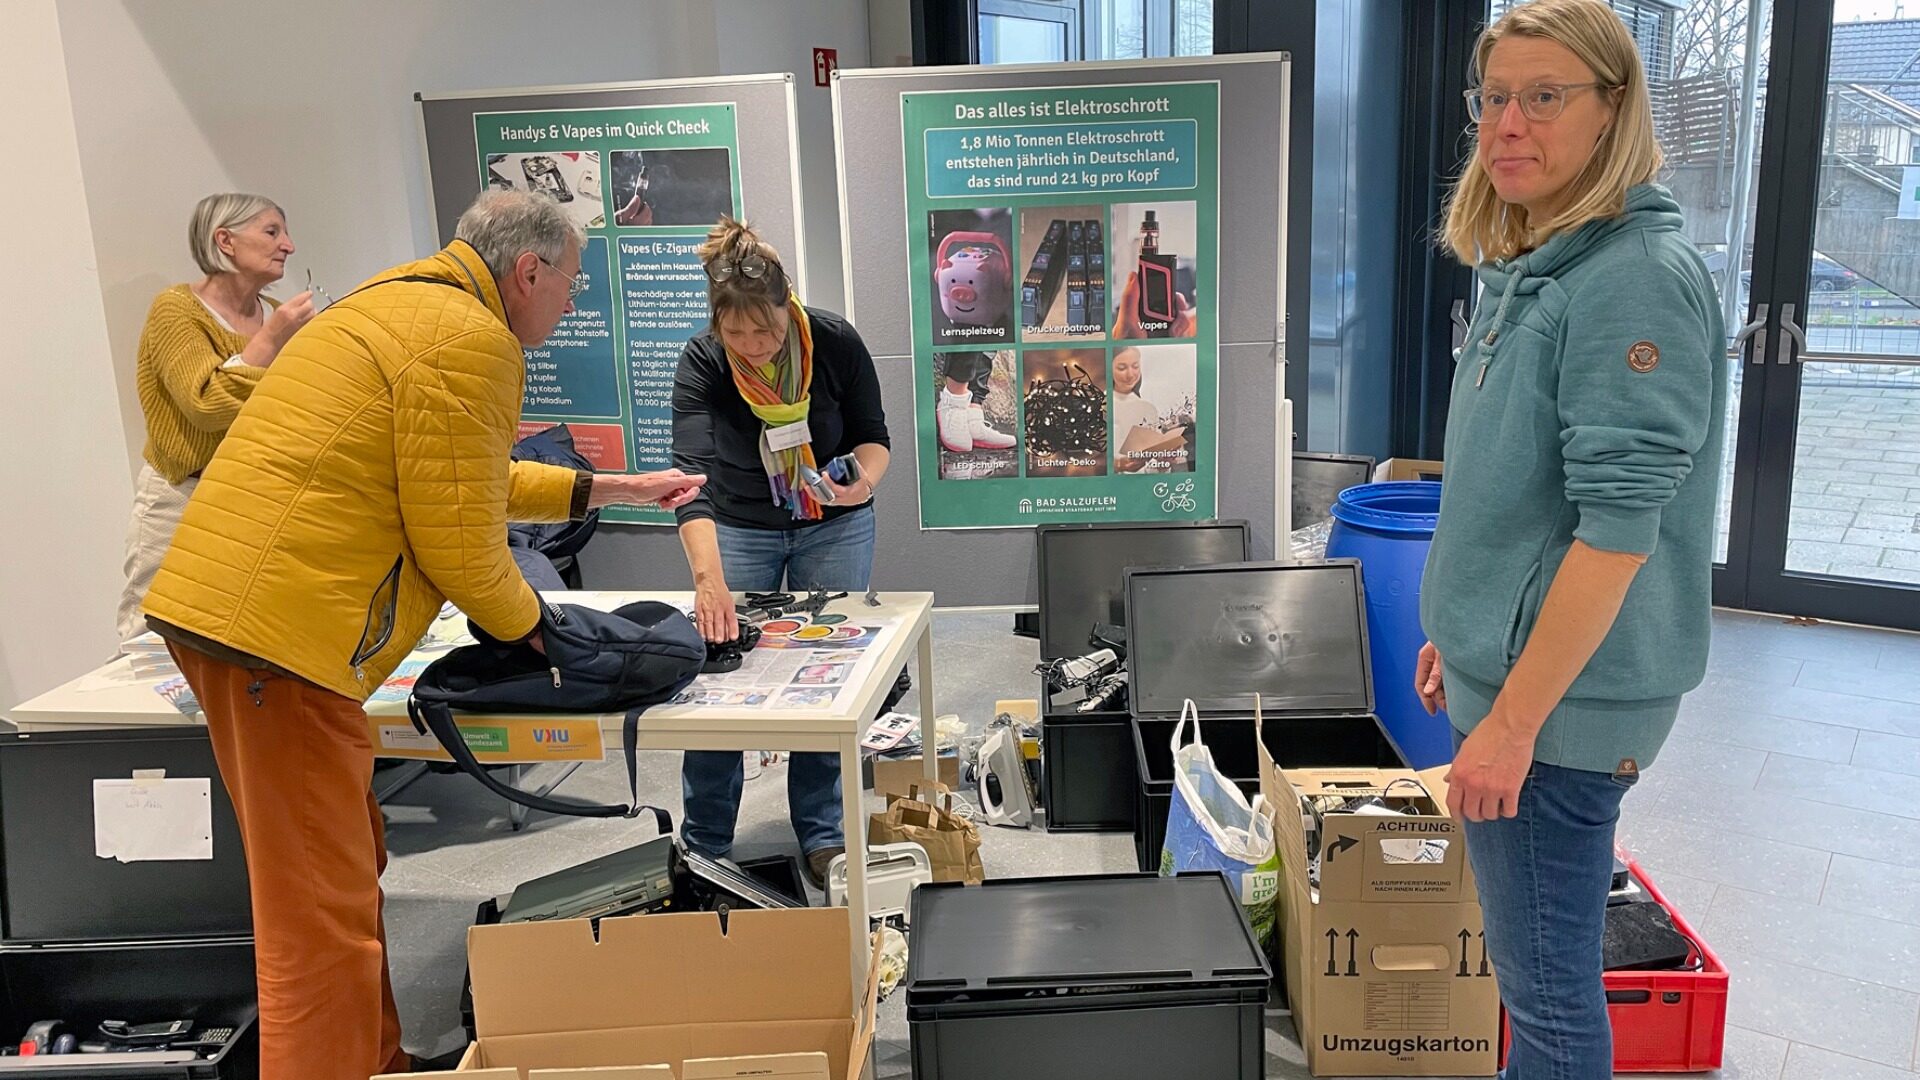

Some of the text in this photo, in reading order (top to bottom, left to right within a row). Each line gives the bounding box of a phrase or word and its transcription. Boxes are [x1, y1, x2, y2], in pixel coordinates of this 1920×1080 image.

[955, 97, 1170, 119] Das alles ist Elektroschrott
[500, 118, 710, 142] Handys & Vapes im Quick Check
[960, 129, 1165, 150] 1,8 Mio Tonnen Elektroschrott
[946, 148, 1180, 171] entstehen jährlich in Deutschland,
[967, 168, 1160, 188] das sind rund 21 kg pro Kopf
[621, 243, 650, 256] Vapes
[661, 262, 672, 271] im
[625, 272, 654, 281] Brände
[627, 290, 708, 300] Beschädigte oder erh
[628, 300, 708, 308] Lithium-Ionen-Akkus
[578, 310, 601, 319] liegen
[629, 310, 658, 318] können
[659, 310, 708, 319] Kurzschlüsse
[569, 321, 606, 329] ungenutzt
[630, 320, 695, 329] Brände auslösen.
[1027, 322, 1101, 335] Druckerpatrone
[1138, 320, 1168, 332] Vapes
[574, 329, 609, 337] Rohstoffe
[941, 326, 1005, 338] Lernspielzeug
[544, 340, 590, 348] martphones:
[631, 340, 688, 350] Falsch entsorgt
[533, 350, 551, 358] Gold
[631, 350, 679, 359] Akku-Geräte
[527, 361, 558, 371] kg Silber
[642, 360, 669, 369] täglich
[534, 373, 557, 383] Kupfer
[641, 370, 675, 378] Müllfahrz
[528, 385, 538, 394] kg
[539, 384, 562, 393] Kobalt
[634, 380, 674, 388] Sortieranla
[634, 389, 673, 399] Recycling
[536, 396, 572, 405] Palladium
[635, 399, 659, 407] 10.000
[638, 426, 662, 436] Vapes
[640, 446, 664, 454] Gelber
[1127, 449, 1189, 459] Elektronische
[641, 456, 670, 464] werden.
[970, 460, 1005, 469] Schuhe
[1037, 457, 1097, 469] Lichter-Deko
[1145, 460, 1171, 468] Karte
[1036, 496, 1117, 507] BAD SALZUFLEN
[463, 732, 490, 740] Umwelt
[533, 728, 569, 743] VKU
[1376, 821, 1456, 833] ACHTUNG:
[1252, 875, 1275, 888] I'm
[1323, 1034, 1489, 1056] Umzugskarton
